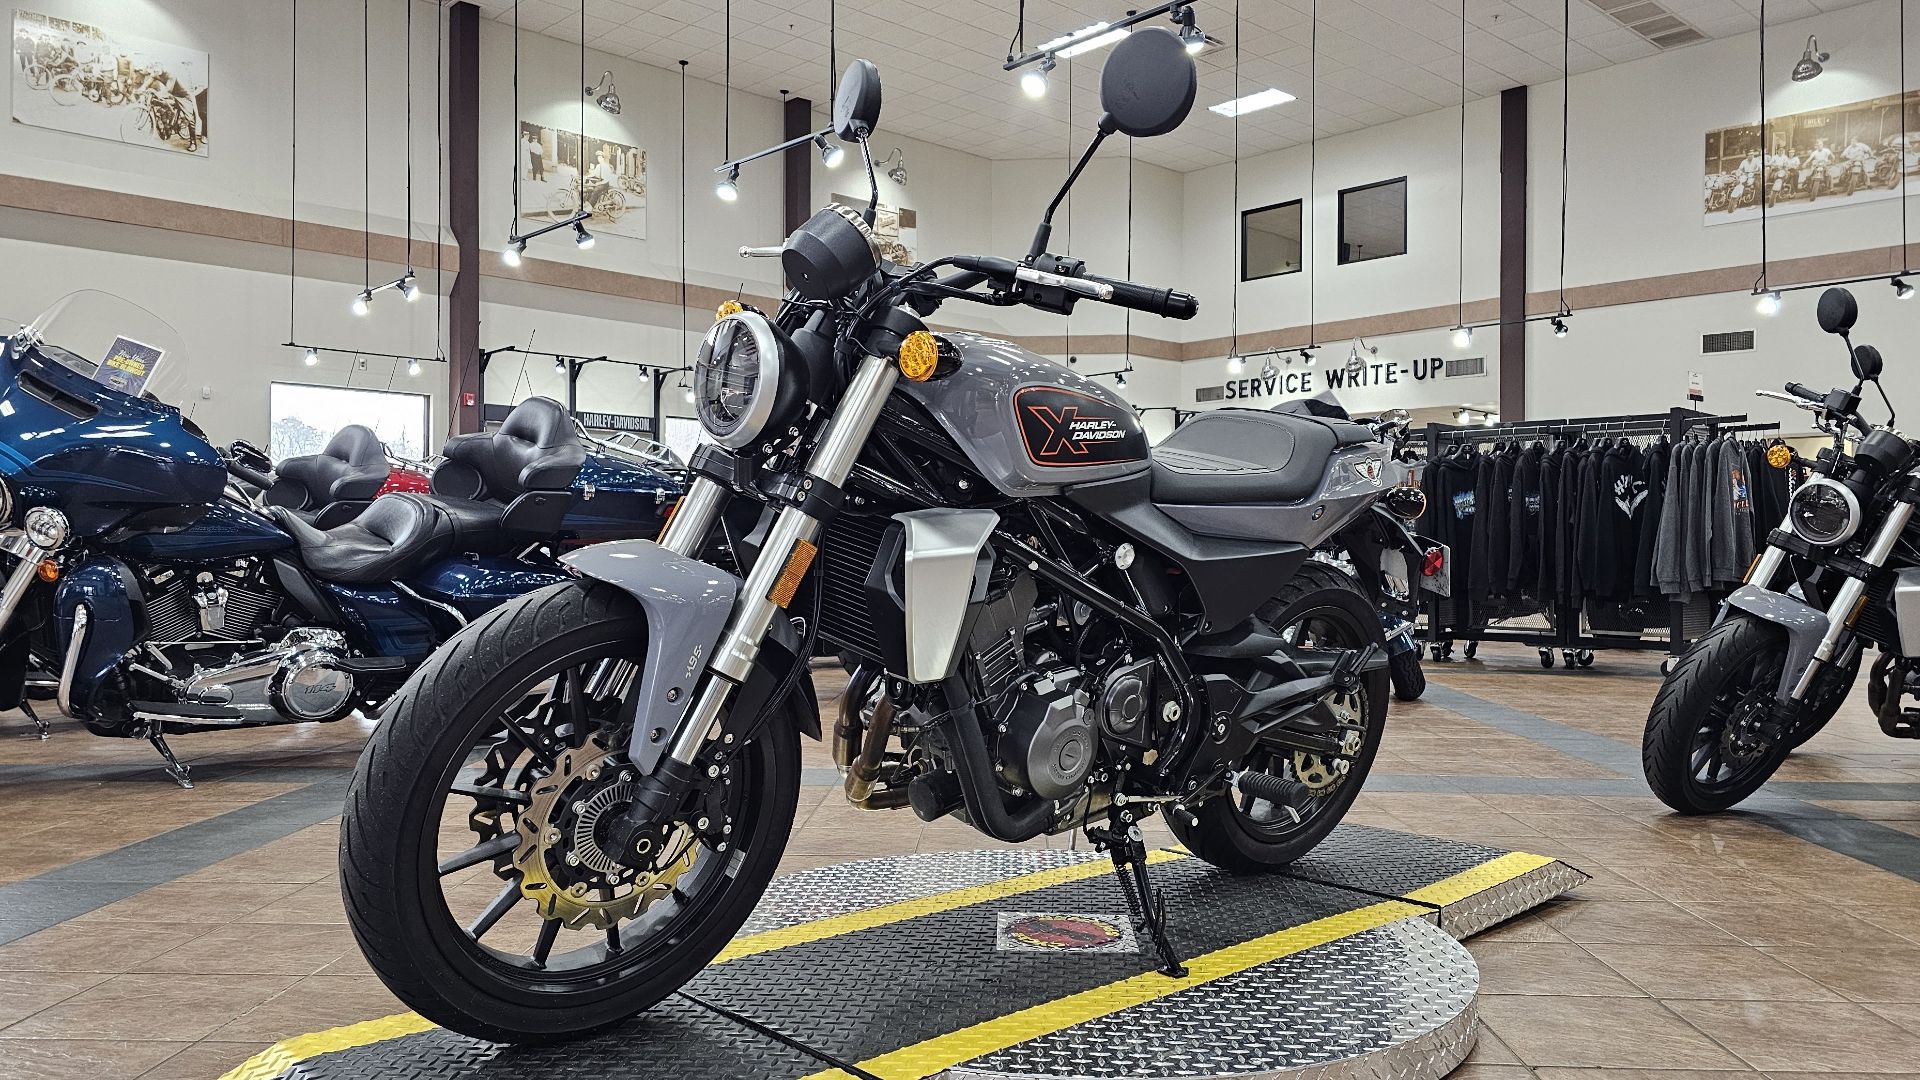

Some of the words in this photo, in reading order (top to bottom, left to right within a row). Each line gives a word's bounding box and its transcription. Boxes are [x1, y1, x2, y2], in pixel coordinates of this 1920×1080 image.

[1225, 372, 1312, 399] SERVICE
[1325, 357, 1444, 389] WRITE-UP
[583, 412, 650, 432] HARLEY-DAVIDSON
[1027, 405, 1089, 456] X
[1068, 420, 1117, 430] HARLEY-
[1071, 429, 1127, 441] DAVIDSON
